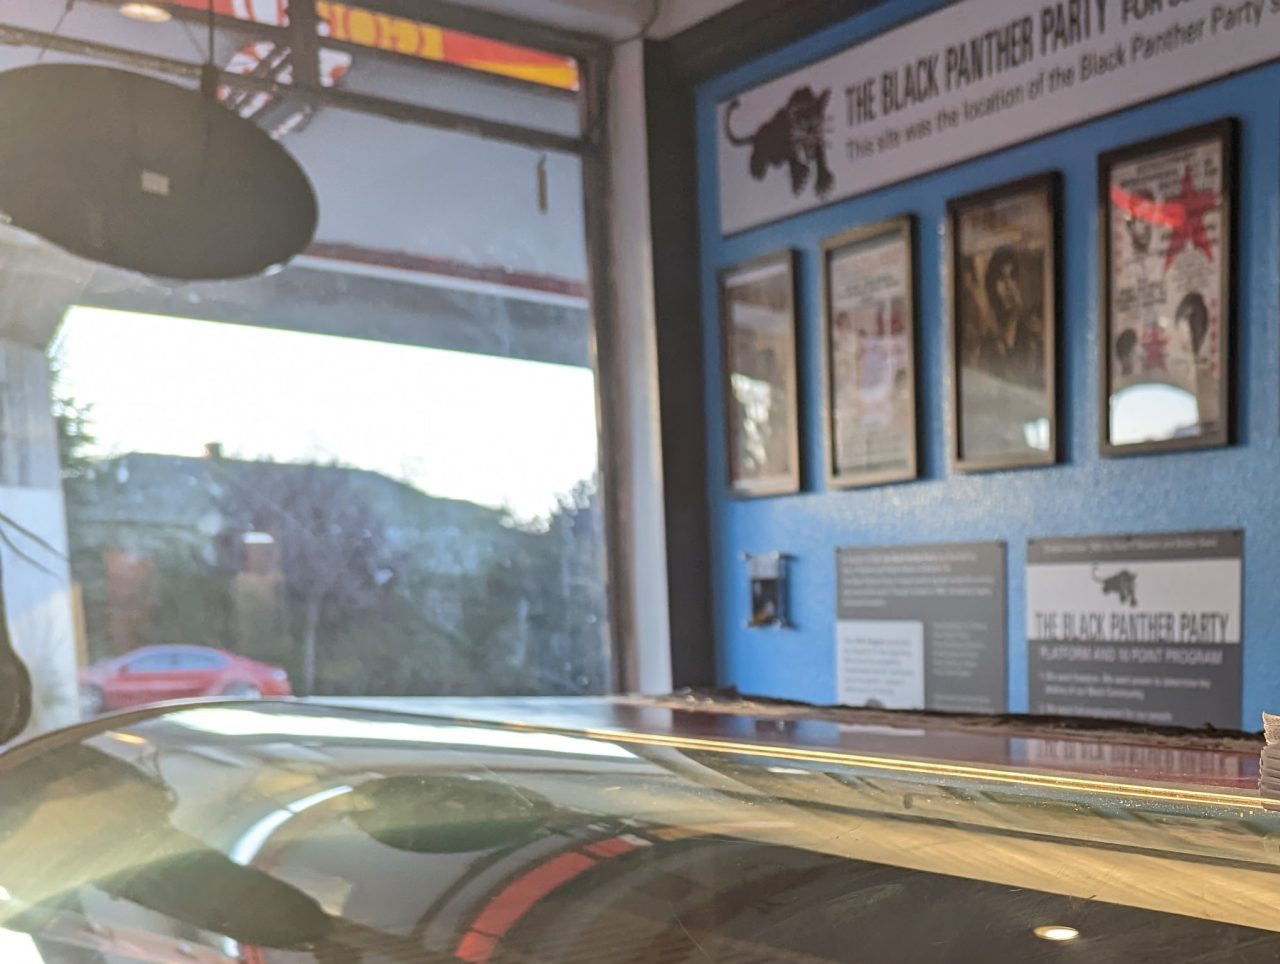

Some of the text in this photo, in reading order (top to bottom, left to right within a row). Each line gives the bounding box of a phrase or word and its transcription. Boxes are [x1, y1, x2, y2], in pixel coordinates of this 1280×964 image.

[845, 78, 877, 126] THE
[882, 54, 940, 115] BLACK
[945, 16, 1033, 92] PANTHER
[1040, 0, 1107, 57] PARTY
[846, 138, 875, 160] This
[877, 128, 899, 150] site
[905, 119, 932, 141] was
[937, 107, 960, 132] the
[964, 84, 1025, 122] location
[1027, 71, 1045, 100] of
[1049, 64, 1076, 92] the
[1080, 42, 1126, 82] Black
[1131, 17, 1206, 62] Panther
[1035, 611, 1230, 644] THE BLACK PANTHER PARTY
